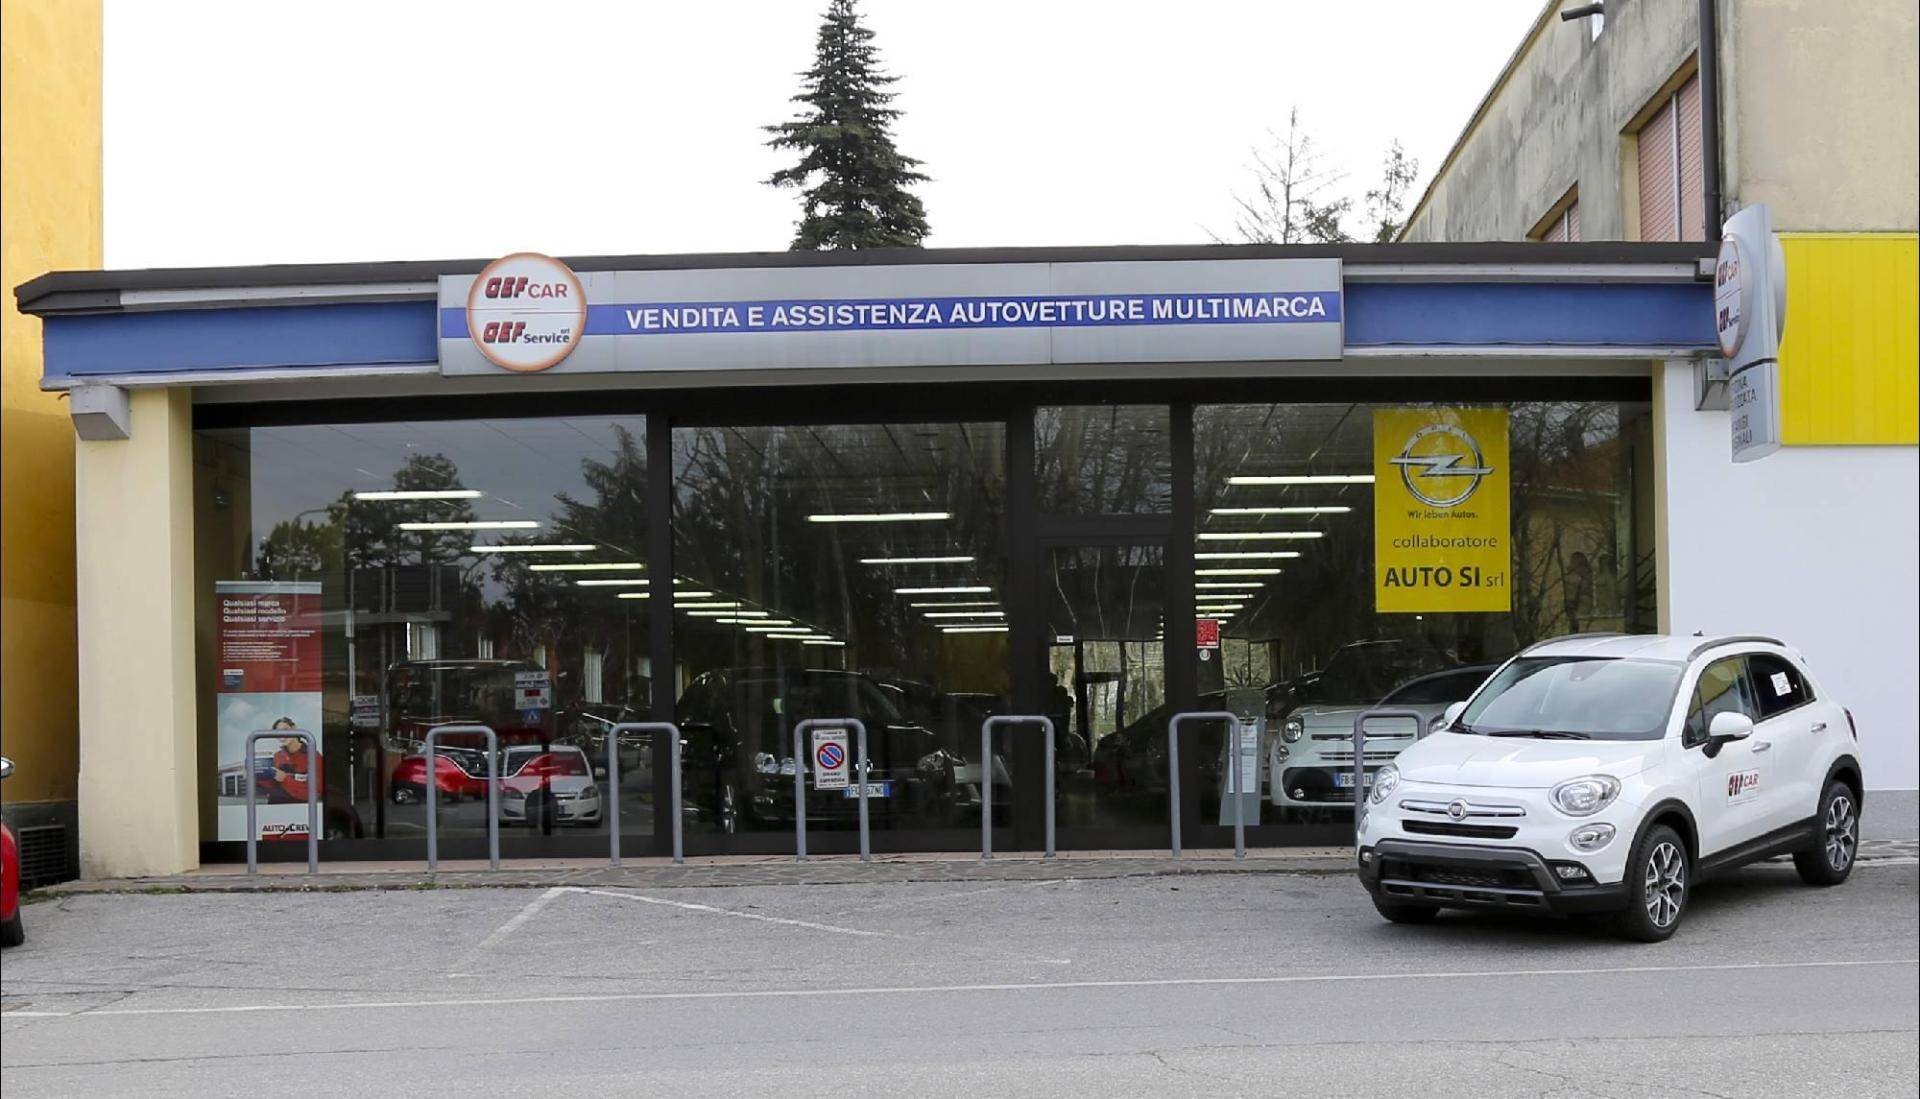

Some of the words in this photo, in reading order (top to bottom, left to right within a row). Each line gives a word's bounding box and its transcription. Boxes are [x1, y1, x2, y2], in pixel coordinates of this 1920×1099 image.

[485, 277, 528, 298] GEF
[528, 283, 567, 298] CAR
[626, 307, 740, 329] VENDITA
[748, 306, 765, 326] E
[771, 303, 942, 326] ASSISTENZA
[949, 299, 1145, 323] AUTOVETTURE
[1152, 296, 1326, 319] MULTIMARCA
[483, 322, 526, 343] GEF
[523, 333, 570, 343] Service
[1408, 510, 1421, 519] Wir
[1424, 509, 1449, 519] leben
[1451, 510, 1479, 519] Autos.
[1392, 534, 1498, 549] collaboratore
[1384, 566, 1453, 588] AUTO
[1459, 566, 1480, 588] SI
[1486, 571, 1504, 588] srl
[1744, 773, 1759, 788] CAR
[262, 824, 286, 832] AUTO
